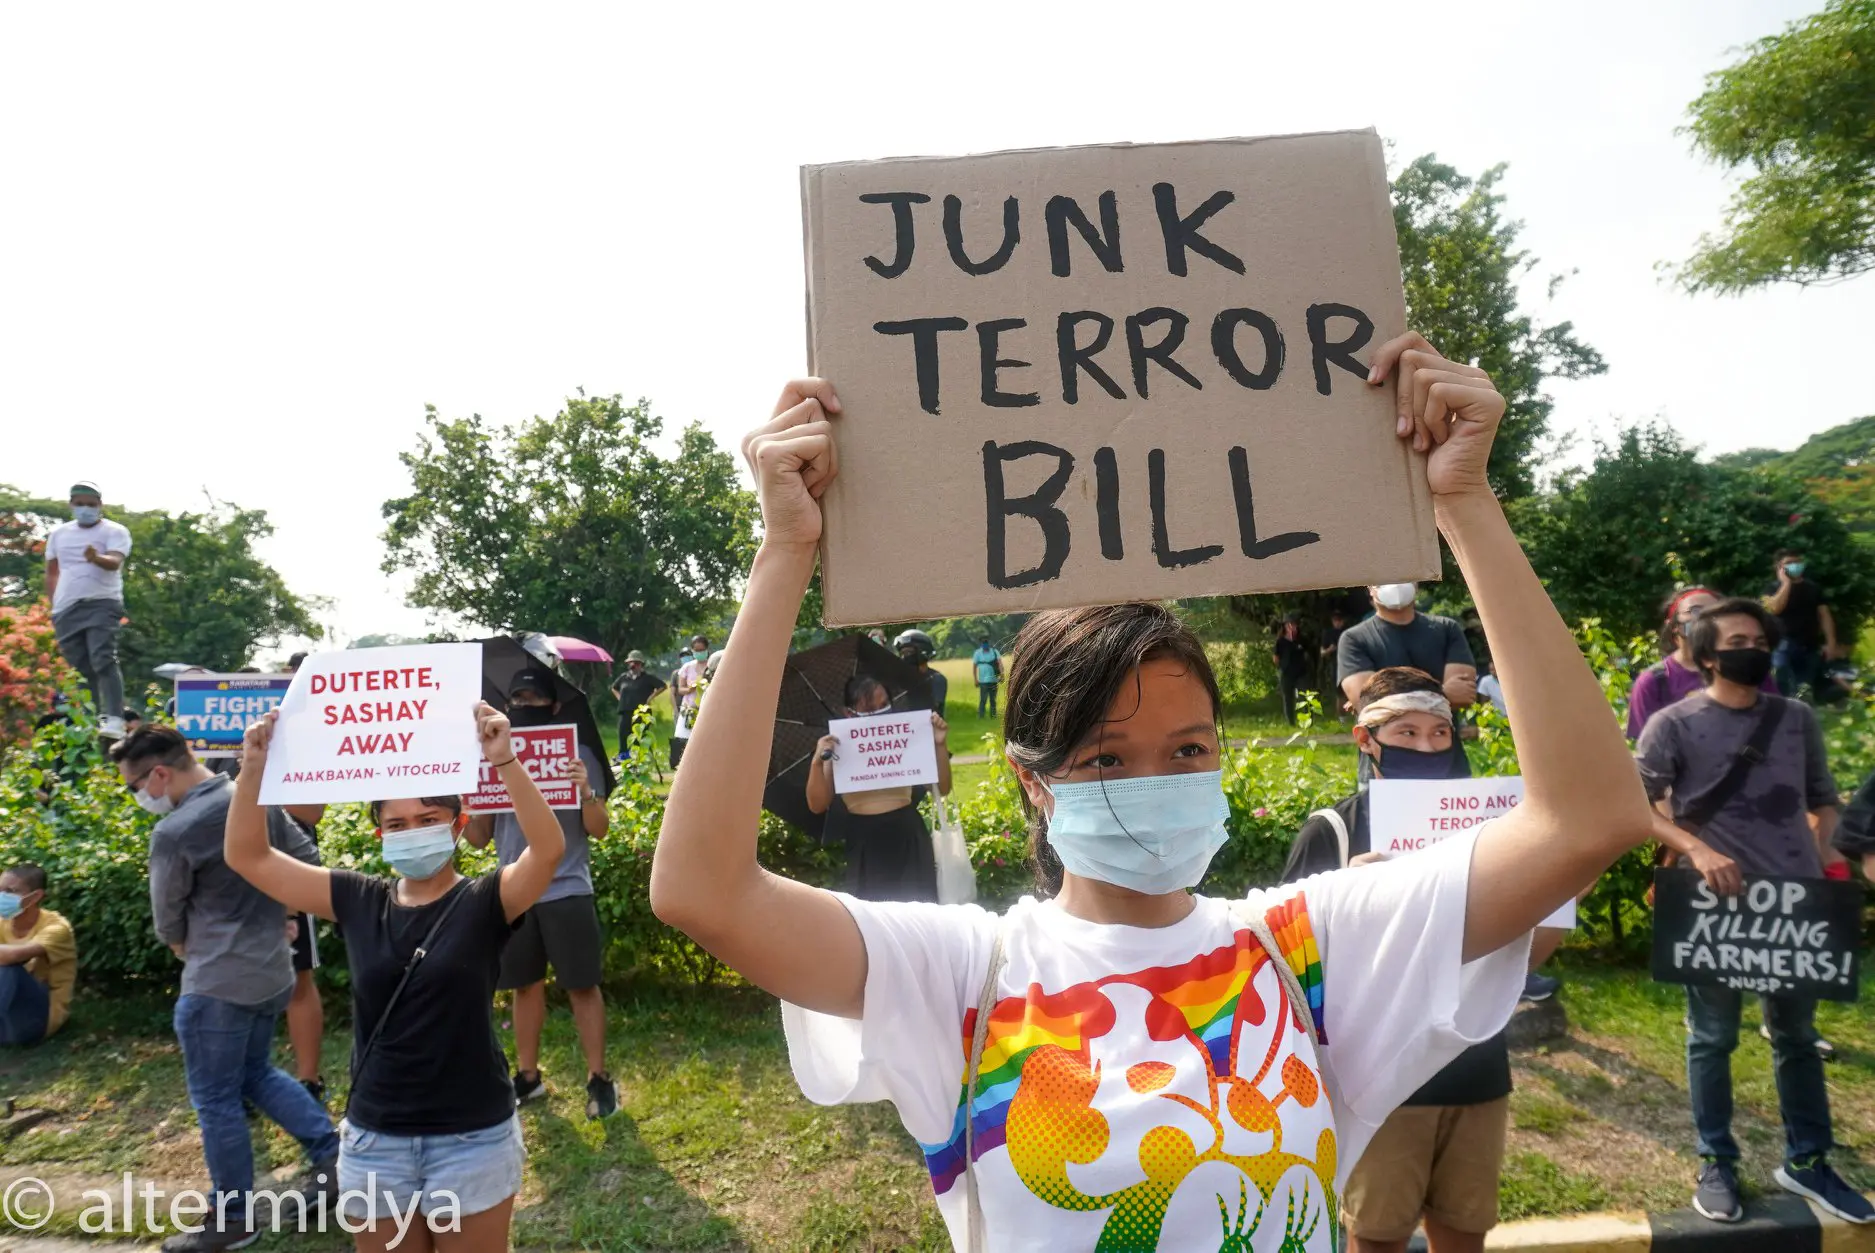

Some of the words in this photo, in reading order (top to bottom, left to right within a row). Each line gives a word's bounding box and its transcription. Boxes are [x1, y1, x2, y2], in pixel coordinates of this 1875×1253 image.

[859, 182, 1246, 278] JUNK
[873, 303, 1383, 415] TERROR
[982, 439, 1320, 589] BILL
[311, 667, 440, 694] DUTERTE,
[204, 697, 281, 713] FIGHT
[324, 700, 428, 725] SASHAY
[850, 723, 914, 739] DUTERTE,
[337, 732, 414, 755] AWAY
[531, 738, 566, 755] THE
[858, 738, 908, 753] SASHAY
[867, 754, 902, 767] AWAY
[387, 762, 461, 777] VITOCRUZ
[850, 774, 878, 782] PANDAY
[468, 794, 513, 805] DEMOCR
[1440, 796, 1480, 810] SINO
[1485, 795, 1518, 808] ANG
[1390, 838, 1426, 851] ANG
[1687, 912, 1829, 948] KILLING
[1673, 942, 1852, 985] FARMERS!
